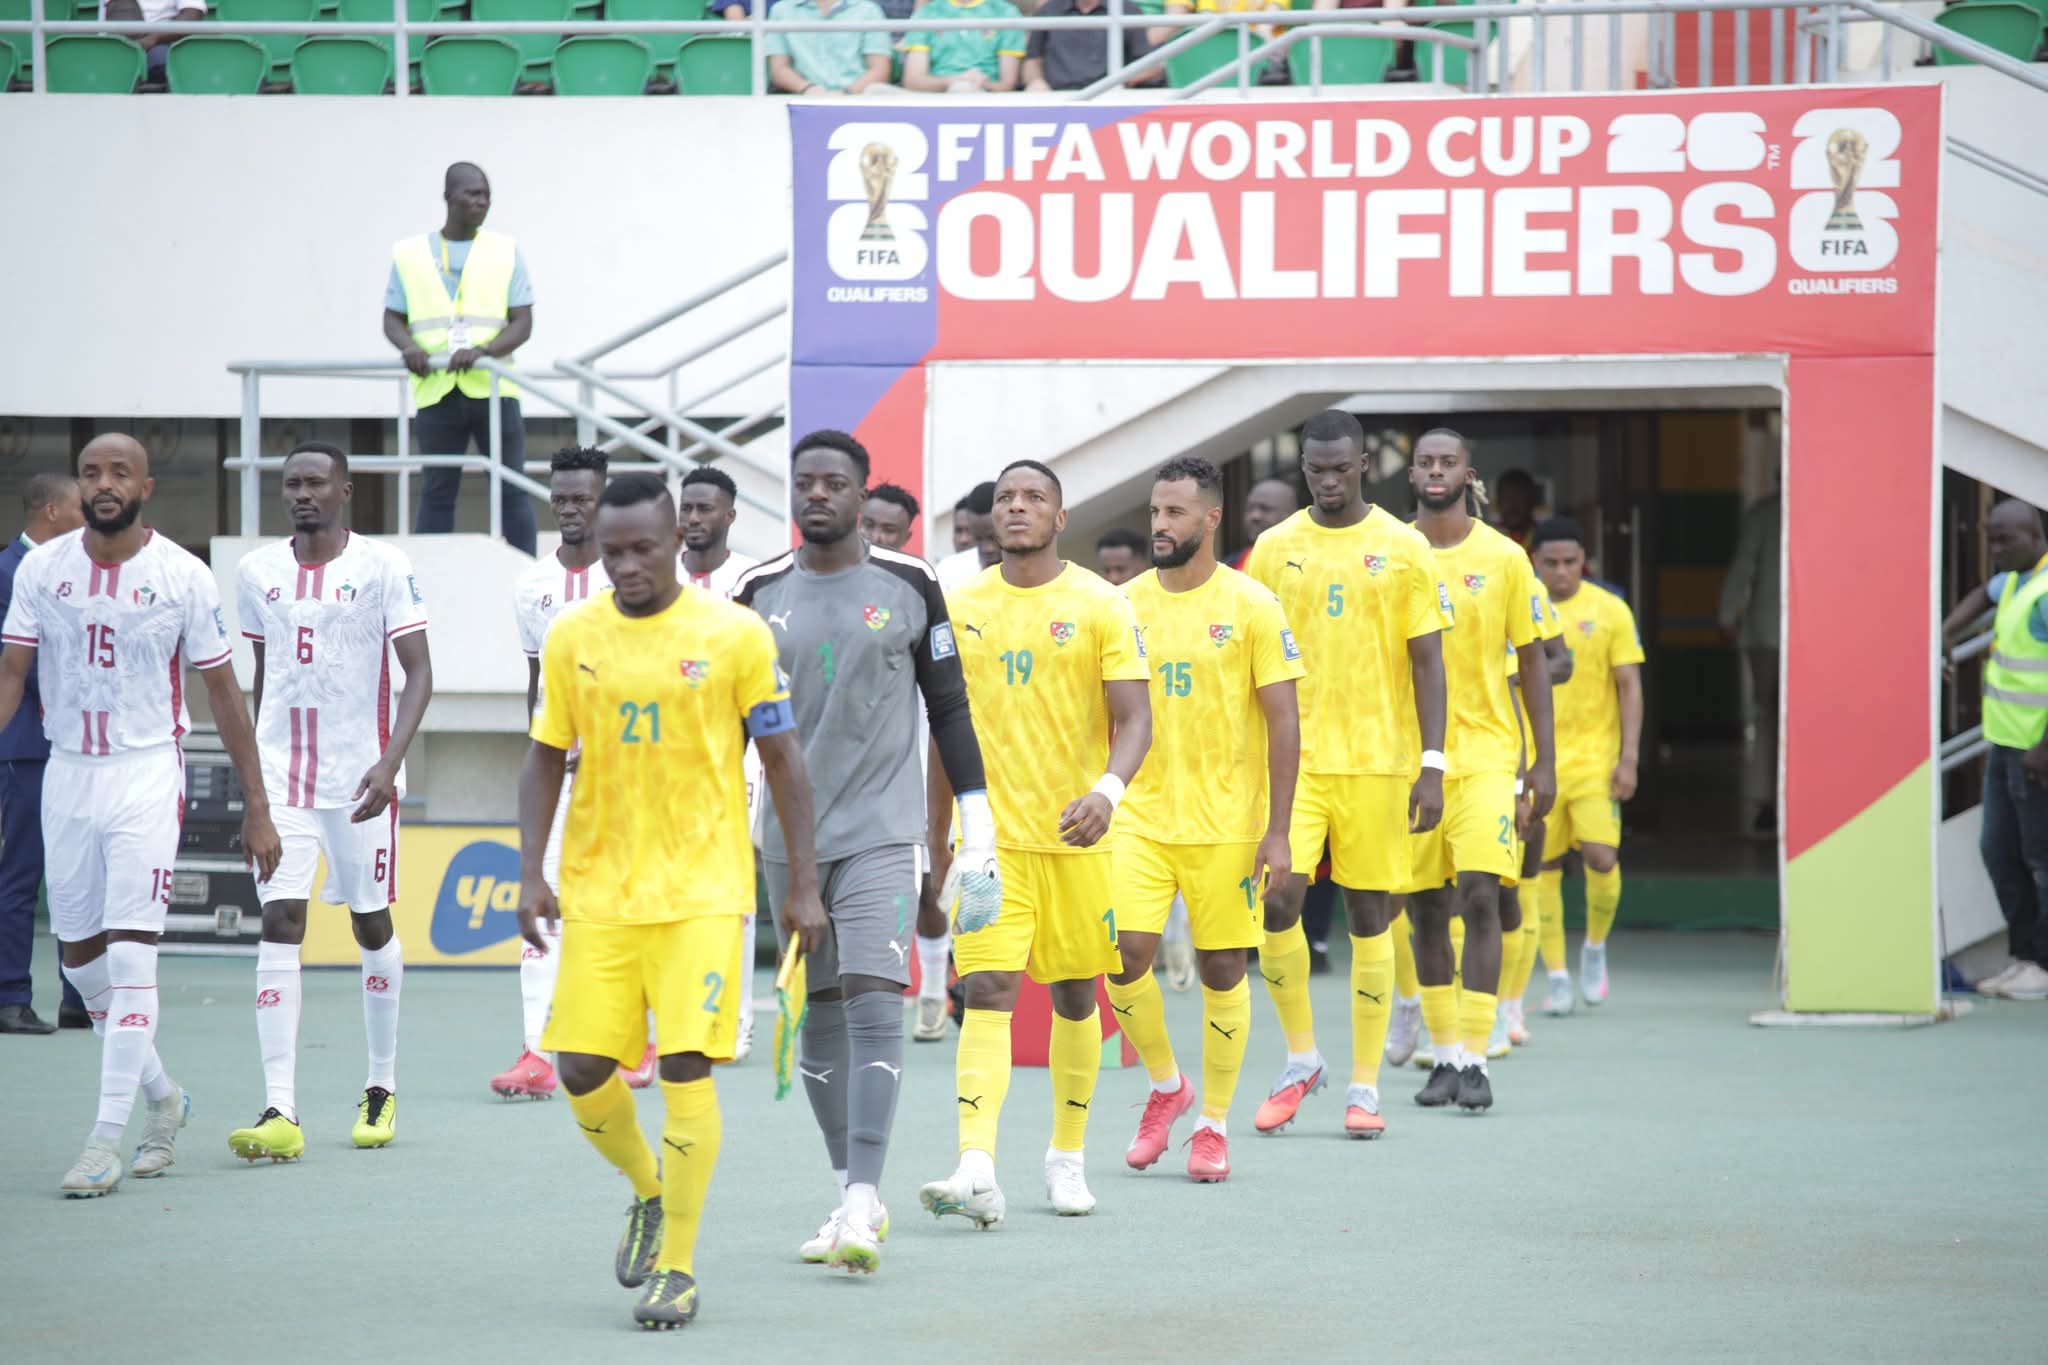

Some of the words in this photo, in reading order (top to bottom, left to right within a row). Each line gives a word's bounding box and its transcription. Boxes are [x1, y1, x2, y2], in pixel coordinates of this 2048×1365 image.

[938, 122, 1106, 182] FIFA
[1117, 118, 1411, 181] WORLD
[1427, 115, 1591, 177] CUP
[1606, 111, 1767, 173] 26
[857, 249, 900, 265] FIFA
[936, 181, 1777, 302] QUALIFIERS
[1821, 240, 1868, 256] FIFA
[827, 286, 929, 303] QUALIFIERS
[1788, 277, 1898, 295] QUALIFIERS
[1327, 584, 1344, 617] 5
[87, 623, 115, 668] 15
[297, 625, 313, 664] 6
[816, 642, 834, 683] 1
[1000, 650, 1033, 685] 19
[1158, 662, 1192, 697] 15
[620, 701, 660, 743] 21
[374, 848, 387, 883] 6
[152, 868, 172, 904] 15
[893, 893, 907, 935] 1
[702, 972, 723, 1013] 2
